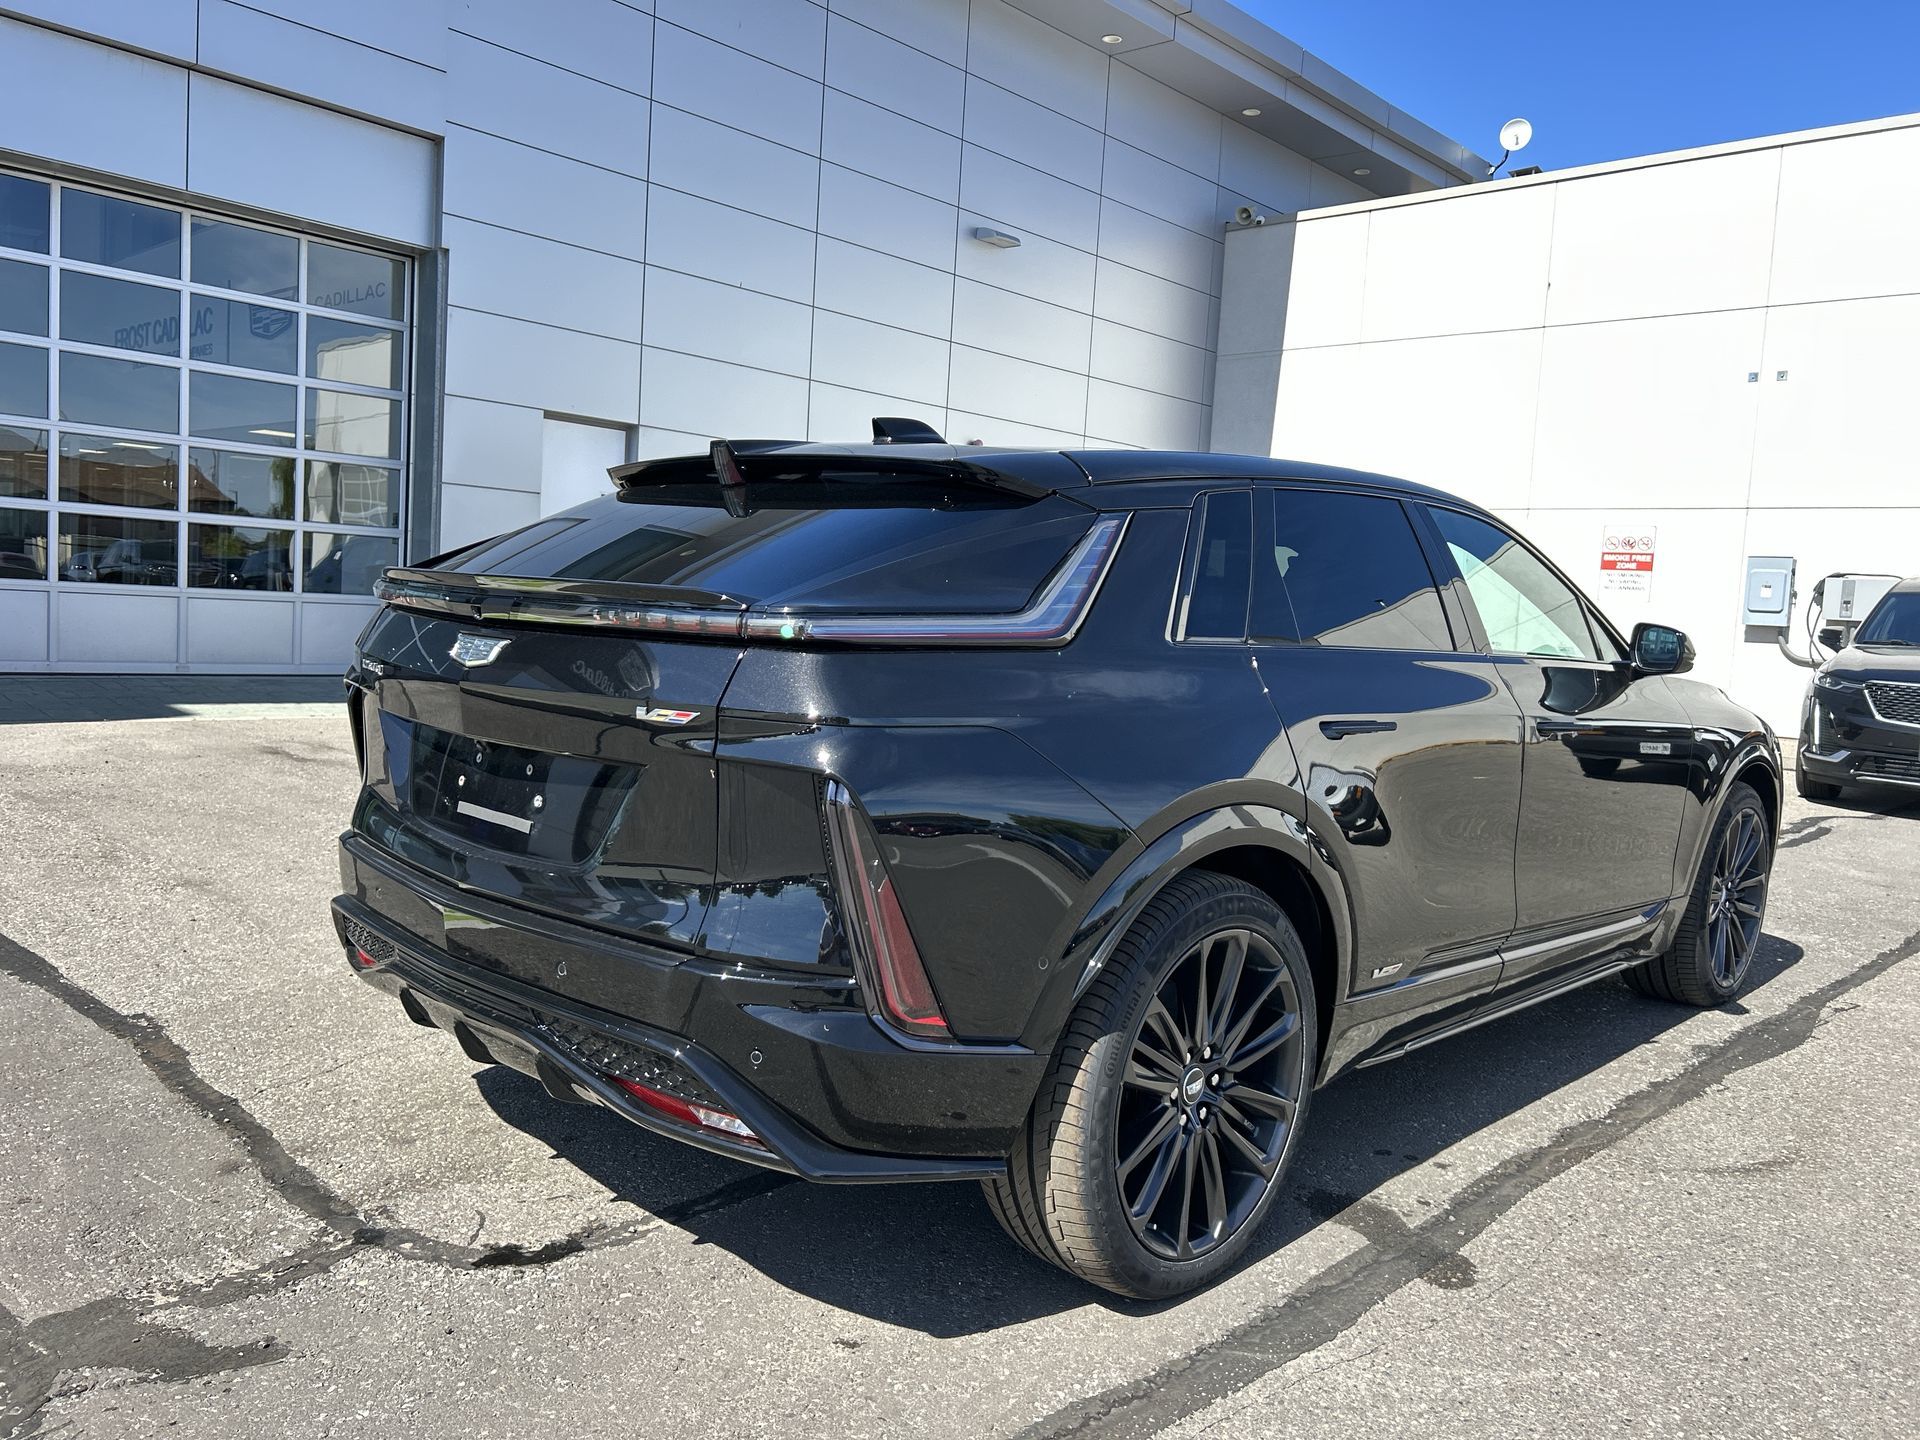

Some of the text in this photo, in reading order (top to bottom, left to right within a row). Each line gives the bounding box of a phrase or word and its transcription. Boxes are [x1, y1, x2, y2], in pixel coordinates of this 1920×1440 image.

[114, 307, 213, 348] FROST CADAC
[1603, 554, 1630, 562] SMOKE
